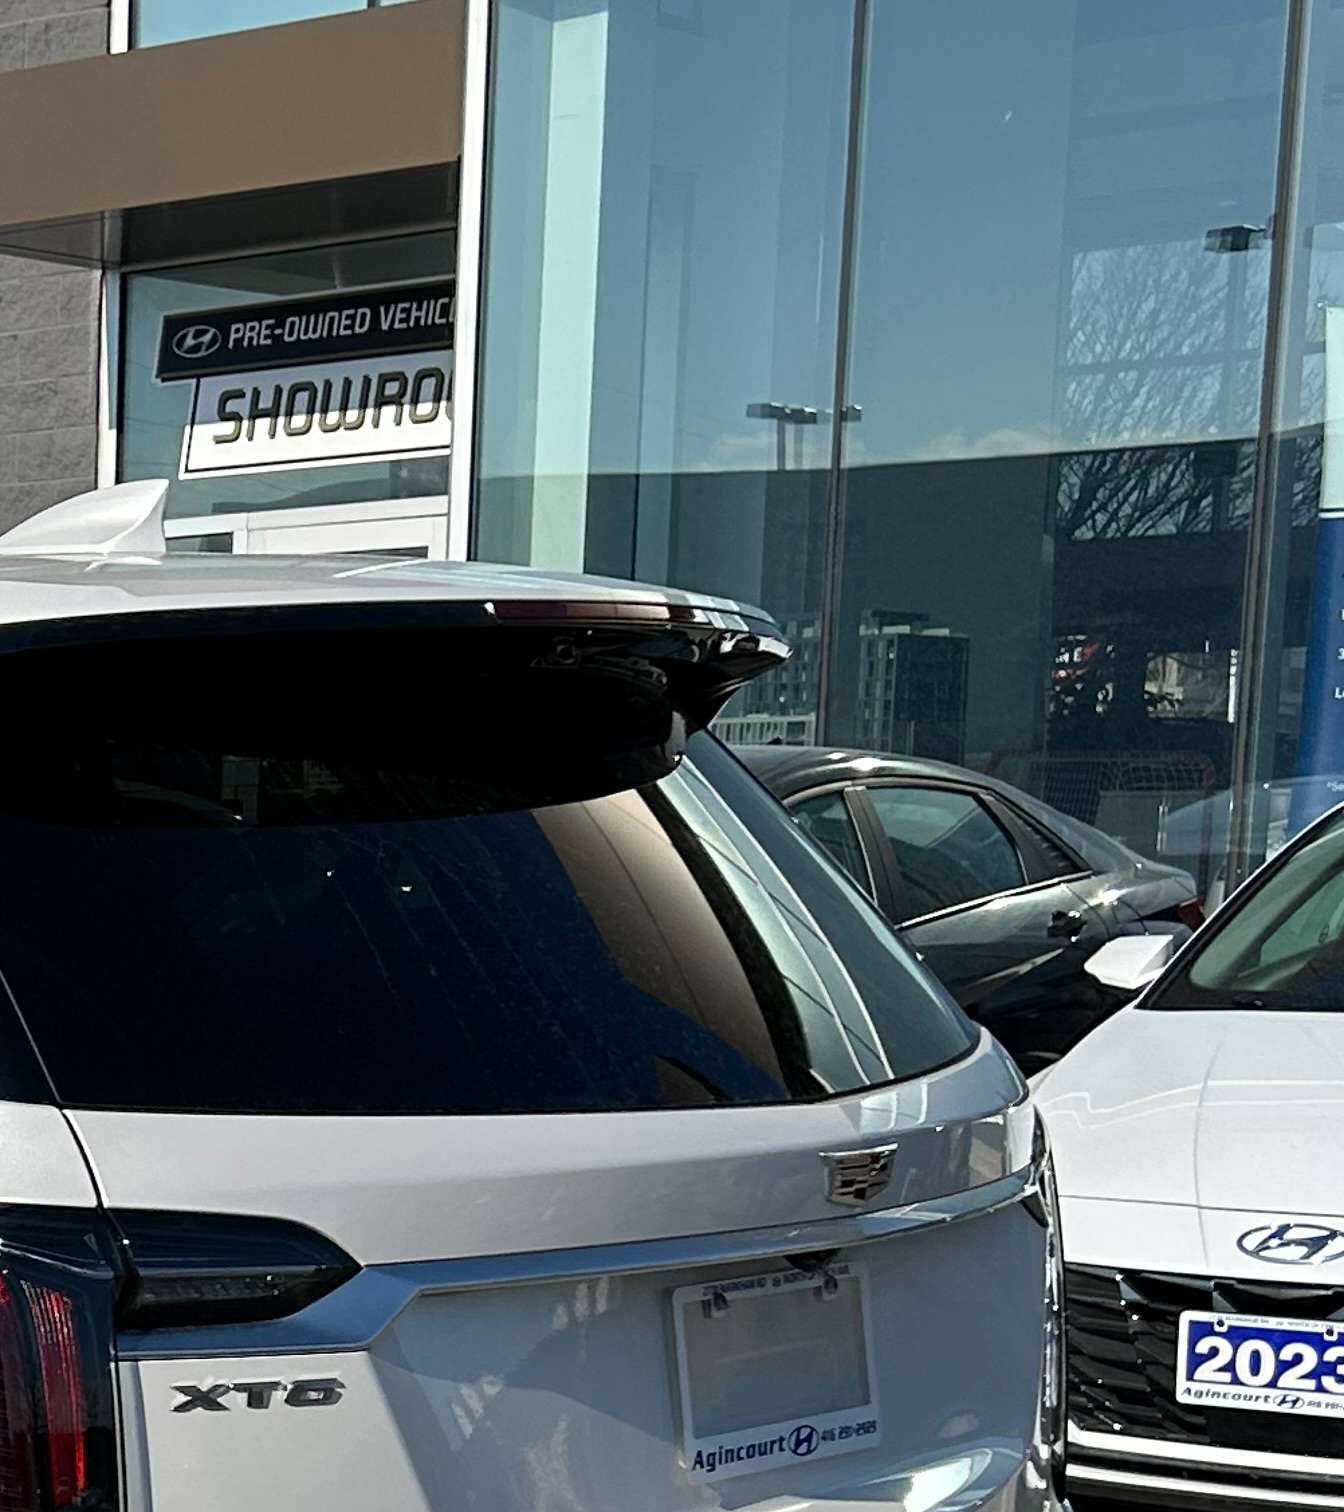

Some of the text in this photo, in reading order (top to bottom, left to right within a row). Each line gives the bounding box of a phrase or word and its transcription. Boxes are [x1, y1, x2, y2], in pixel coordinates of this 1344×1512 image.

[227, 306, 371, 350] PRE-OWNED
[212, 366, 454, 445] SHOWRO
[1193, 1336, 1344, 1394] 2023
[169, 1378, 346, 1413] XT6
[1181, 1387, 1272, 1403] Agincourt
[692, 1435, 787, 1473] Agincourt
